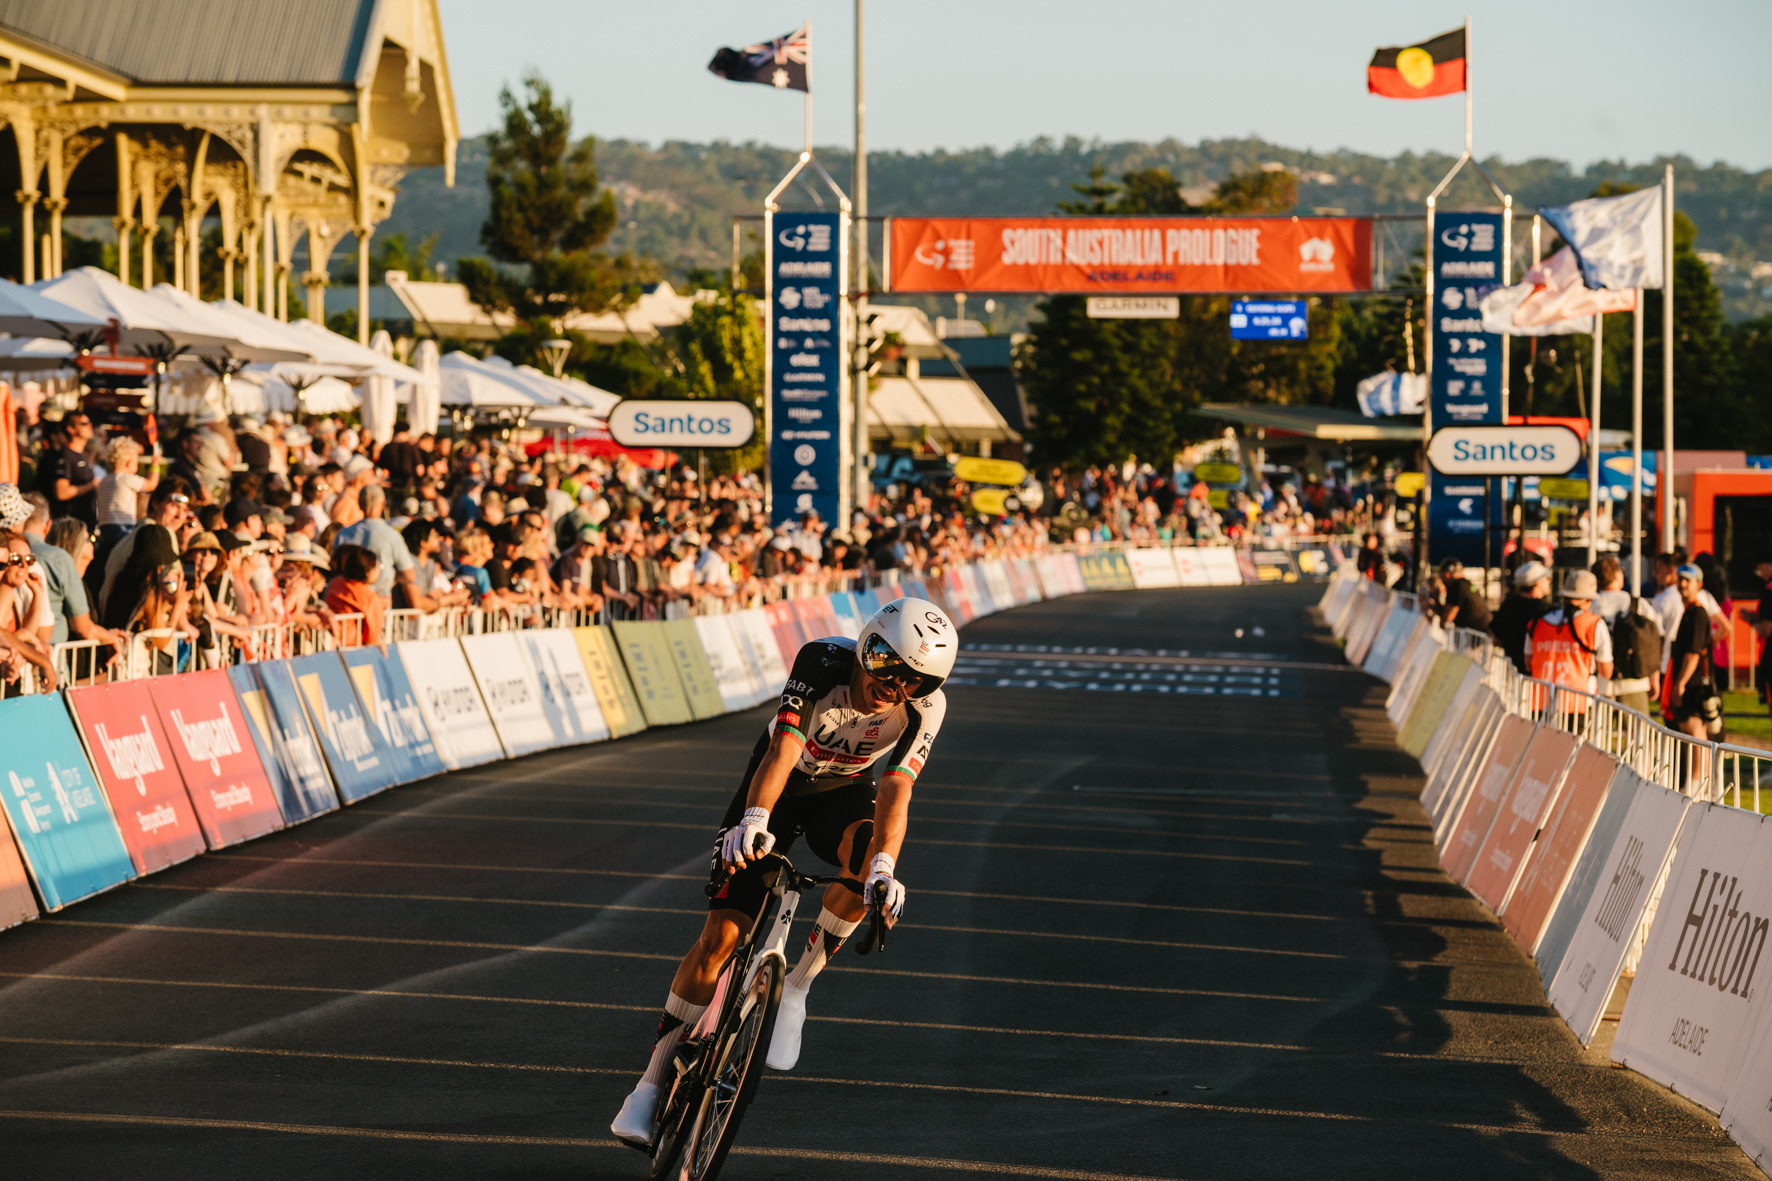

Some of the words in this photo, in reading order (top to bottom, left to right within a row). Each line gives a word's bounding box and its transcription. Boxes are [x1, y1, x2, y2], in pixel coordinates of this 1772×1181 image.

[1001, 228, 1062, 265] SOUTH
[1065, 228, 1163, 265] AUSTRALIA
[1166, 228, 1261, 265] PROLOGUE
[1087, 270, 1175, 282] ADELAIDE
[634, 412, 731, 434] Santos
[1453, 440, 1556, 461] Santos
[908, 655, 926, 667] MET
[94, 714, 165, 797] Vanguard
[169, 701, 243, 777] Vanguard
[814, 723, 876, 757] UAE
[1594, 834, 1645, 943] Hilton
[1668, 868, 1770, 999] Hilton
[1668, 1017, 1709, 1057] ADELAIDE
